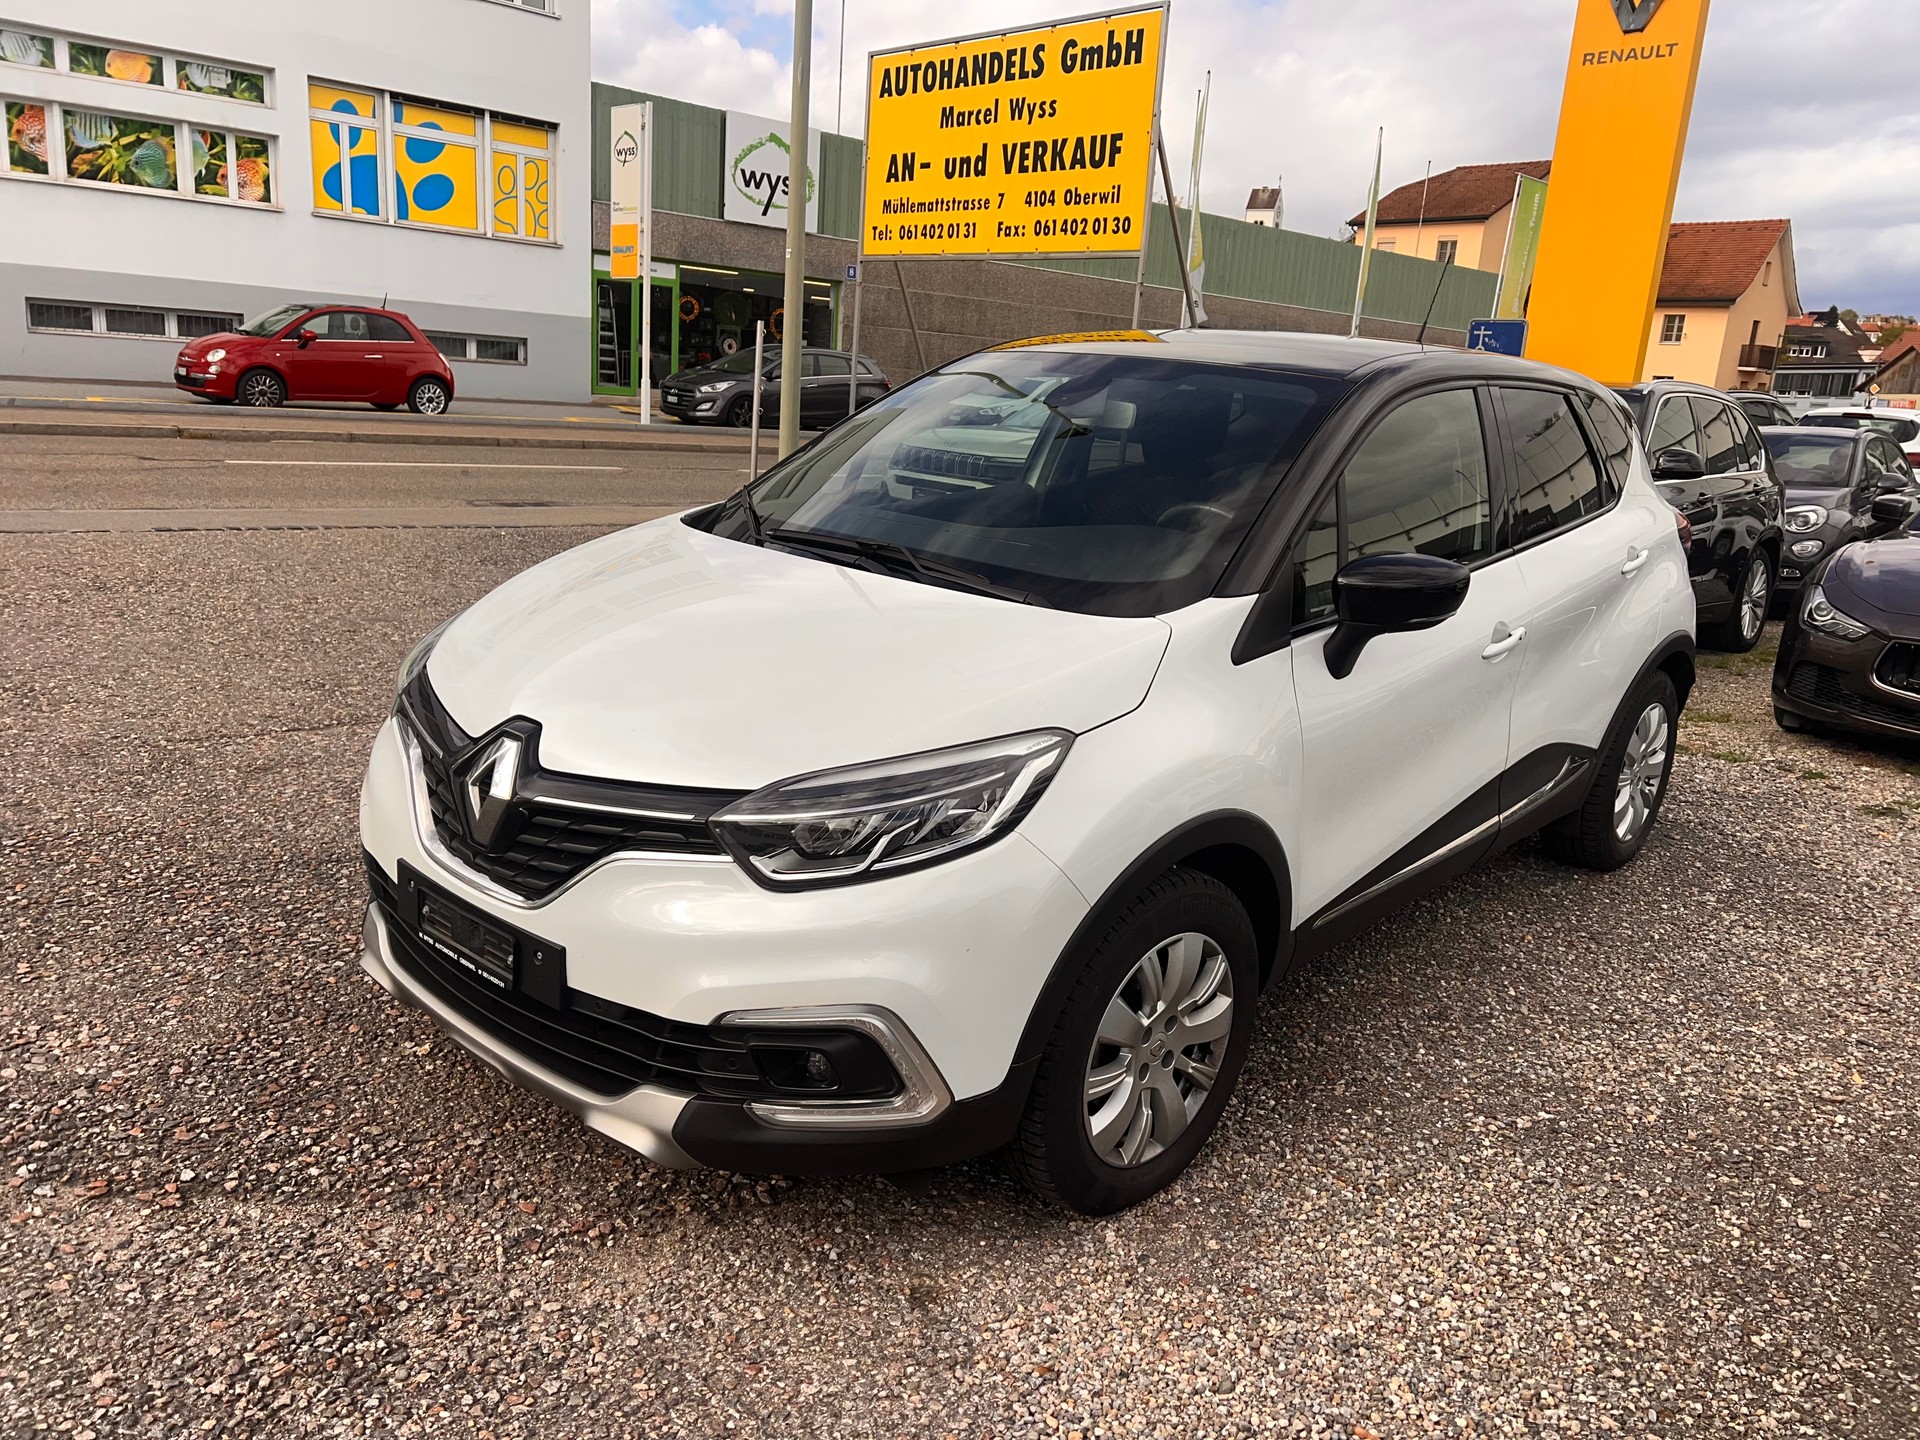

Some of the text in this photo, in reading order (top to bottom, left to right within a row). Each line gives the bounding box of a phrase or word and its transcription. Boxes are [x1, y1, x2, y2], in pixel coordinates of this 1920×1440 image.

[878, 28, 1145, 99] AUTOHANDELS GmbH
[1582, 43, 1679, 66] RENAULT
[940, 97, 1057, 129] Marcel Wyss
[616, 147, 635, 167] wyss
[886, 133, 1124, 183] AN- und VERKAUF
[740, 168, 789, 217] wys
[882, 185, 1121, 215] Mühlemattstrasse 7 4104 Oberwil
[872, 225, 892, 241] Tel:
[997, 222, 1026, 238] Fax:
[849, 267, 855, 276] 8
[434, 942, 458, 961] AUTOMOBILE
